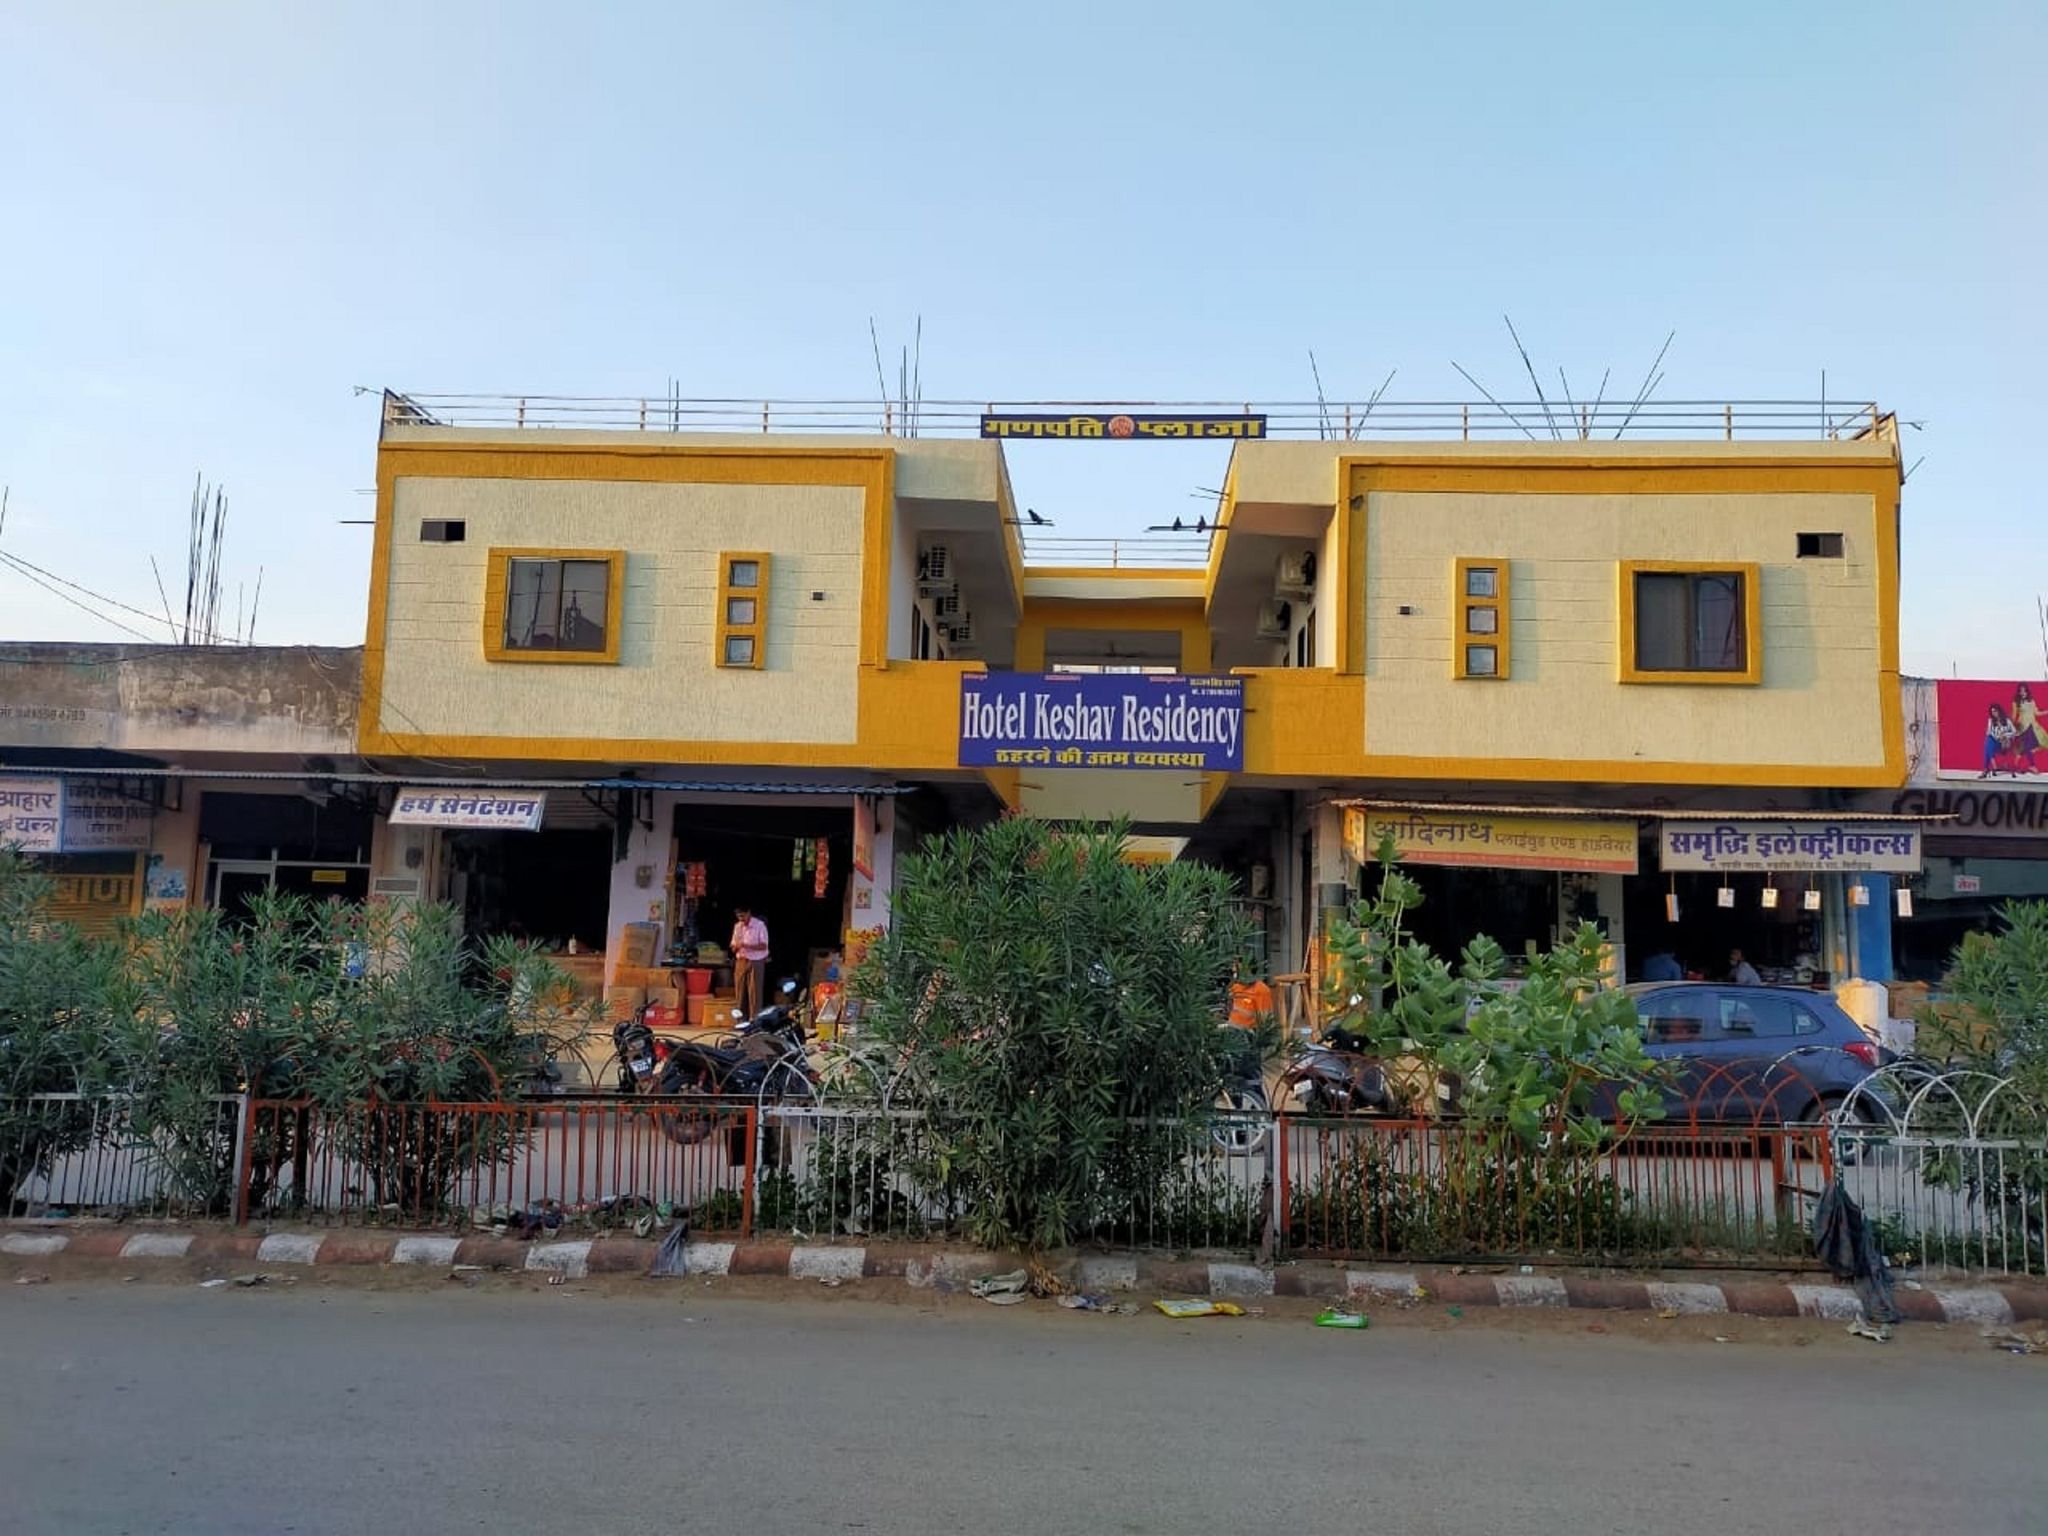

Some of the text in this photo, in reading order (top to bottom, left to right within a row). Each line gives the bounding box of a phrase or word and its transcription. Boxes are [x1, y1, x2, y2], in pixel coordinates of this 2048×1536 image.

[985, 416, 1263, 437] गणपति प्लाजा
[962, 692, 1242, 758] Hotel Keshav Residency
[995, 746, 1206, 768] ठहरने की उत्तम व्यवस्था
[0, 790, 56, 812] आहार
[399, 793, 539, 816] हर्ष सेनेटेशन
[15, 816, 58, 833] यन्त्र
[1371, 813, 1493, 845] आदिनाथ
[1669, 825, 1750, 861] समृद्धि
[1755, 825, 1914, 860] इलेक्ट्रीकल्स
